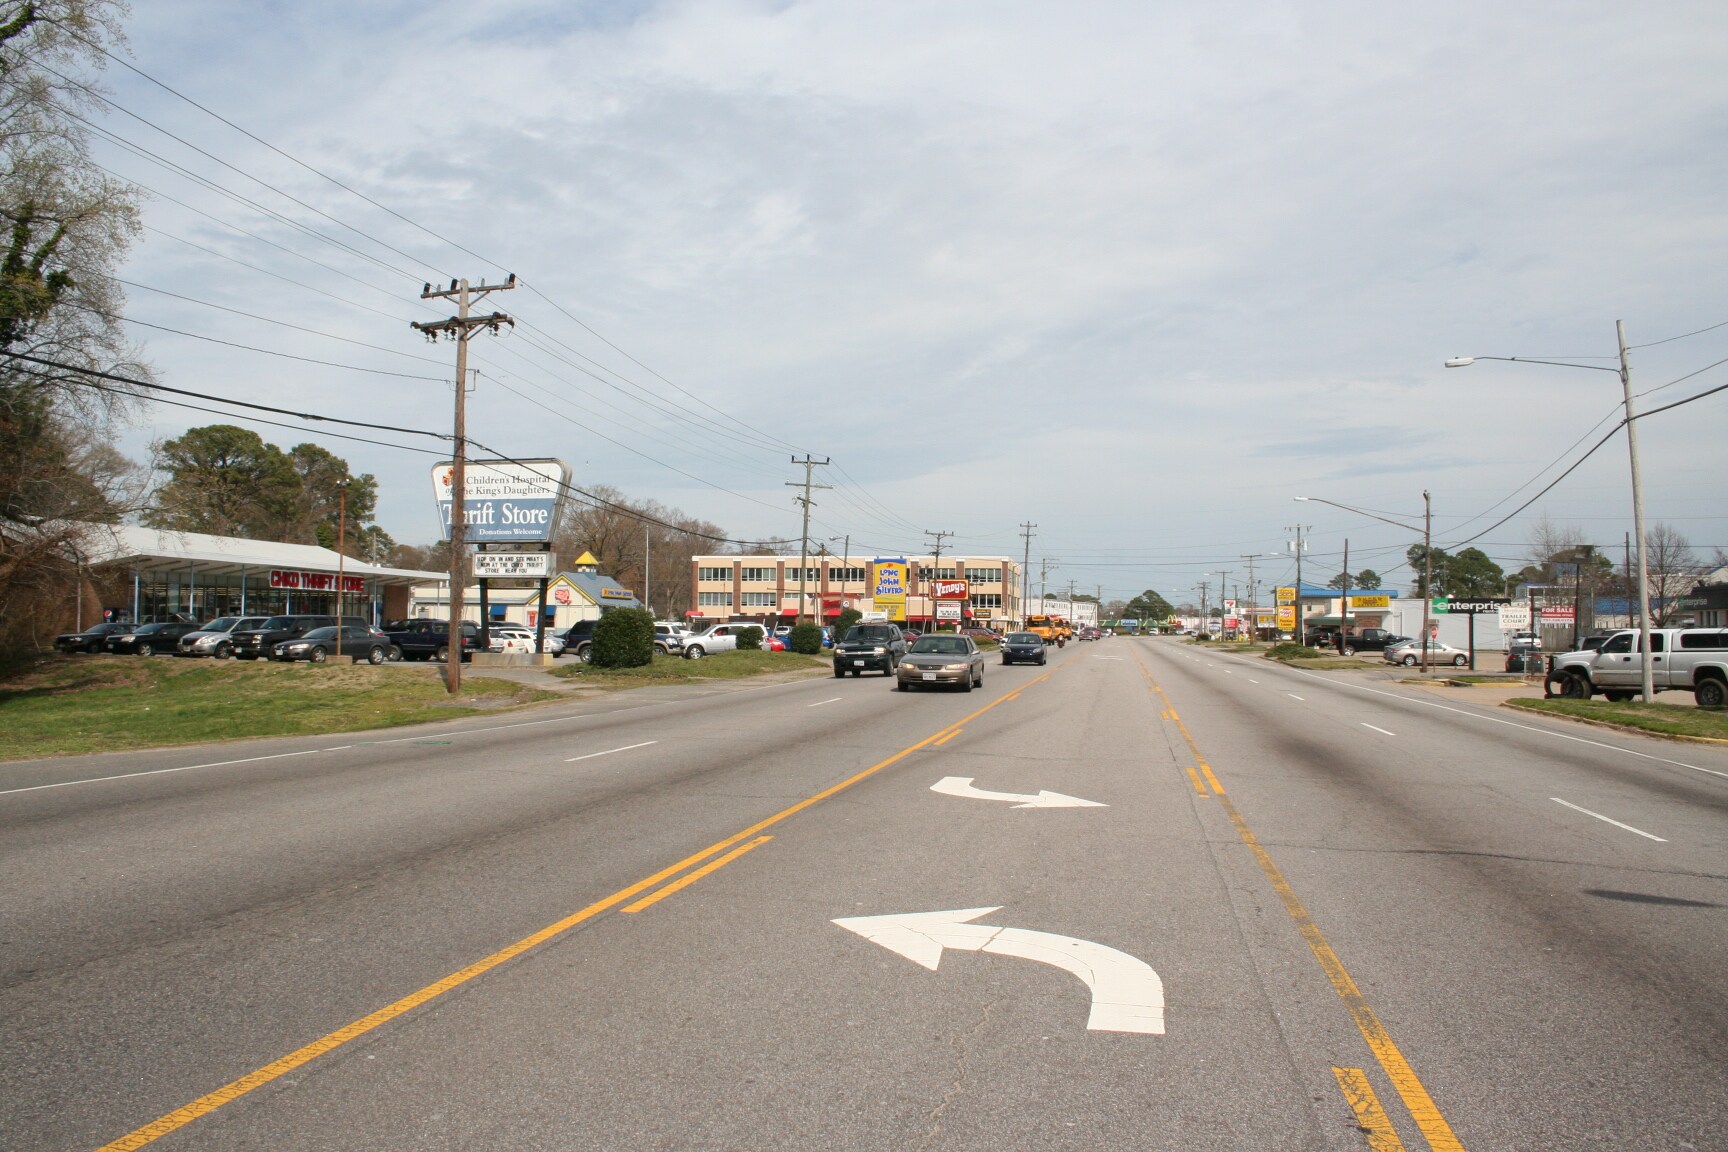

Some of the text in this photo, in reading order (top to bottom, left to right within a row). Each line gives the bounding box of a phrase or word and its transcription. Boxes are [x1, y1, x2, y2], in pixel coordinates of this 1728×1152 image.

[466, 474, 550, 485] Children's Hospital
[476, 486, 501, 497] King's
[504, 485, 550, 497] Daughters
[502, 503, 548, 525] Store
[479, 528, 512, 536] Donations
[880, 569, 898, 577] LONG
[301, 572, 334, 590] THRIFT
[334, 574, 365, 592] STORE
[879, 577, 899, 585] JOHN
